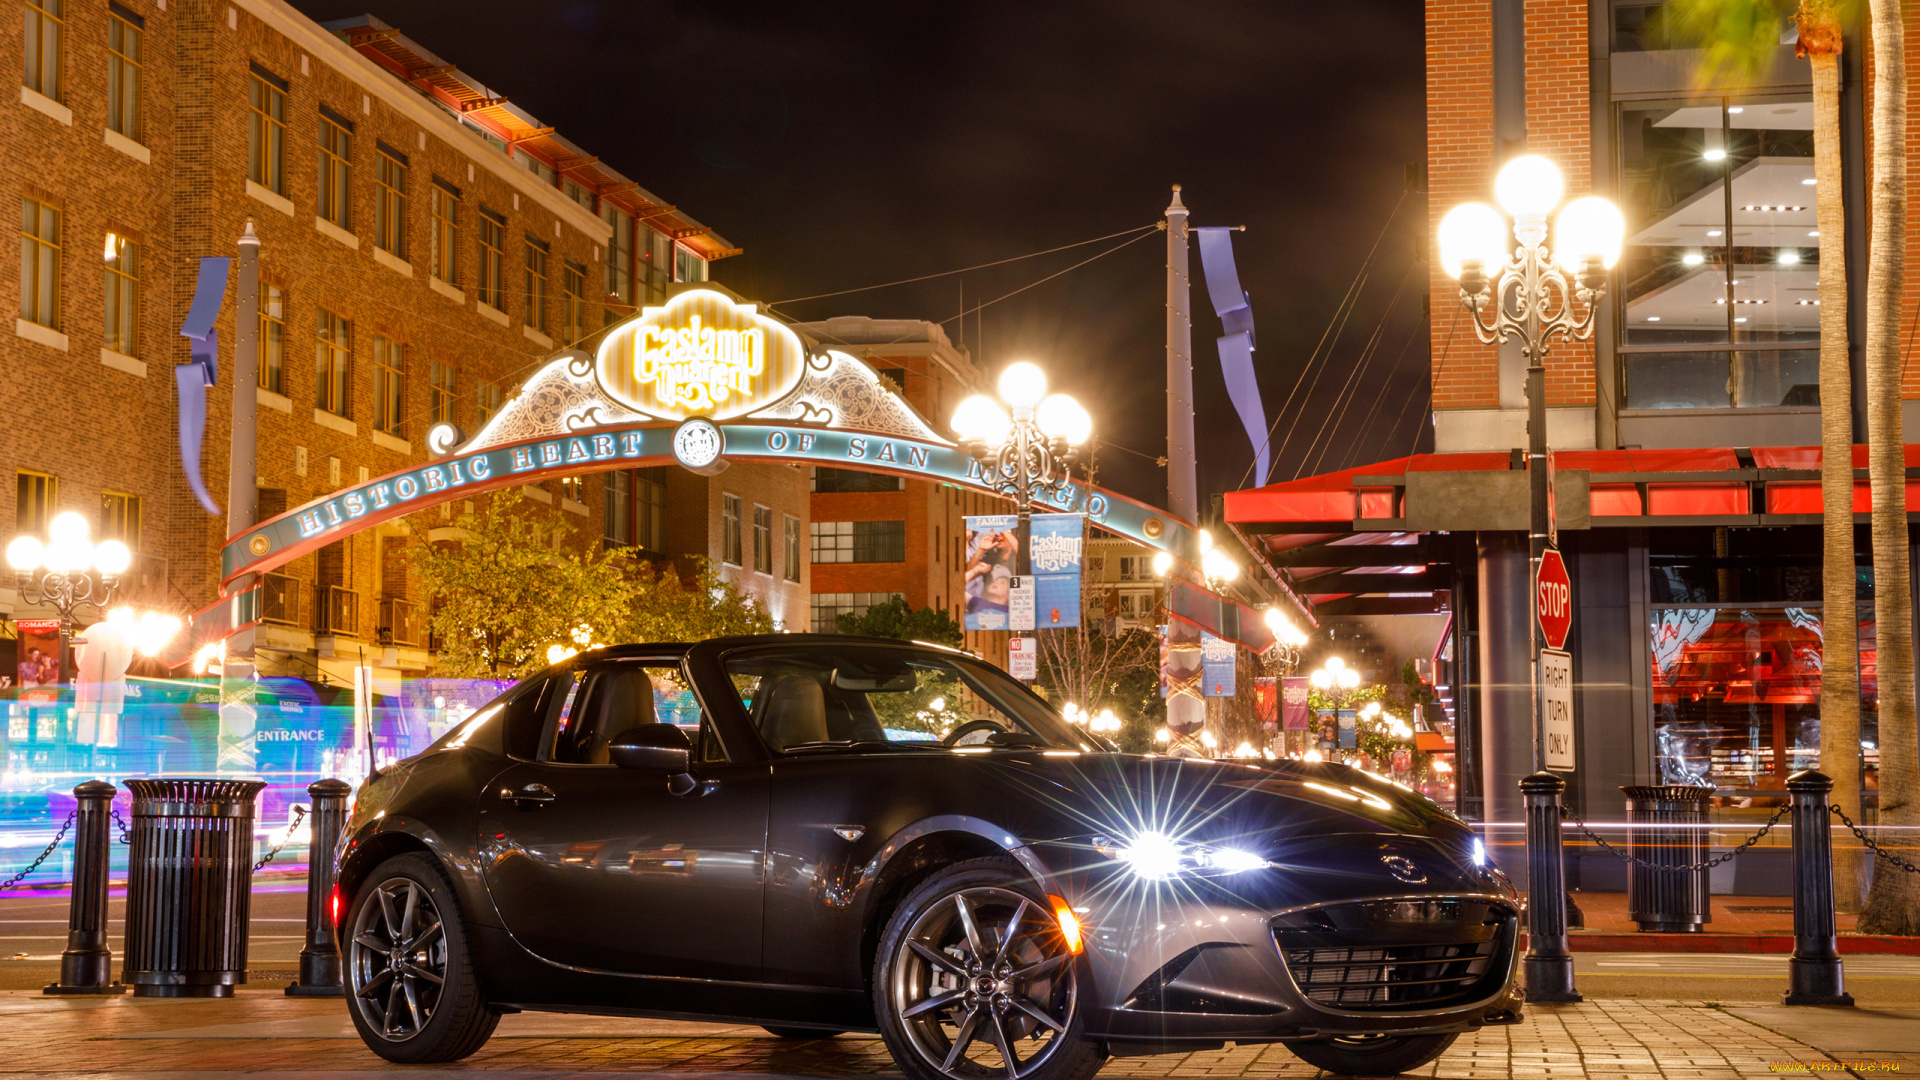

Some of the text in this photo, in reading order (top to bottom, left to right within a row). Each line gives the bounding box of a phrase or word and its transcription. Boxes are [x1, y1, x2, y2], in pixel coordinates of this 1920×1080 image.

[295, 455, 490, 537] HISTORIC
[510, 432, 643, 471] HEART
[767, 431, 816, 453] OF
[848, 438, 931, 468] SAN
[976, 517, 1009, 526] FAMILY
[1013, 577, 1018, 588] 3
[1539, 581, 1569, 618] STOP
[1011, 640, 1021, 650] NO
[1011, 652, 1035, 661] PARKING
[1545, 665, 1569, 689] RIGHT
[1547, 699, 1569, 722] TURN
[256, 729, 325, 741] ENTRANCE
[1549, 733, 1569, 755] ONLY
